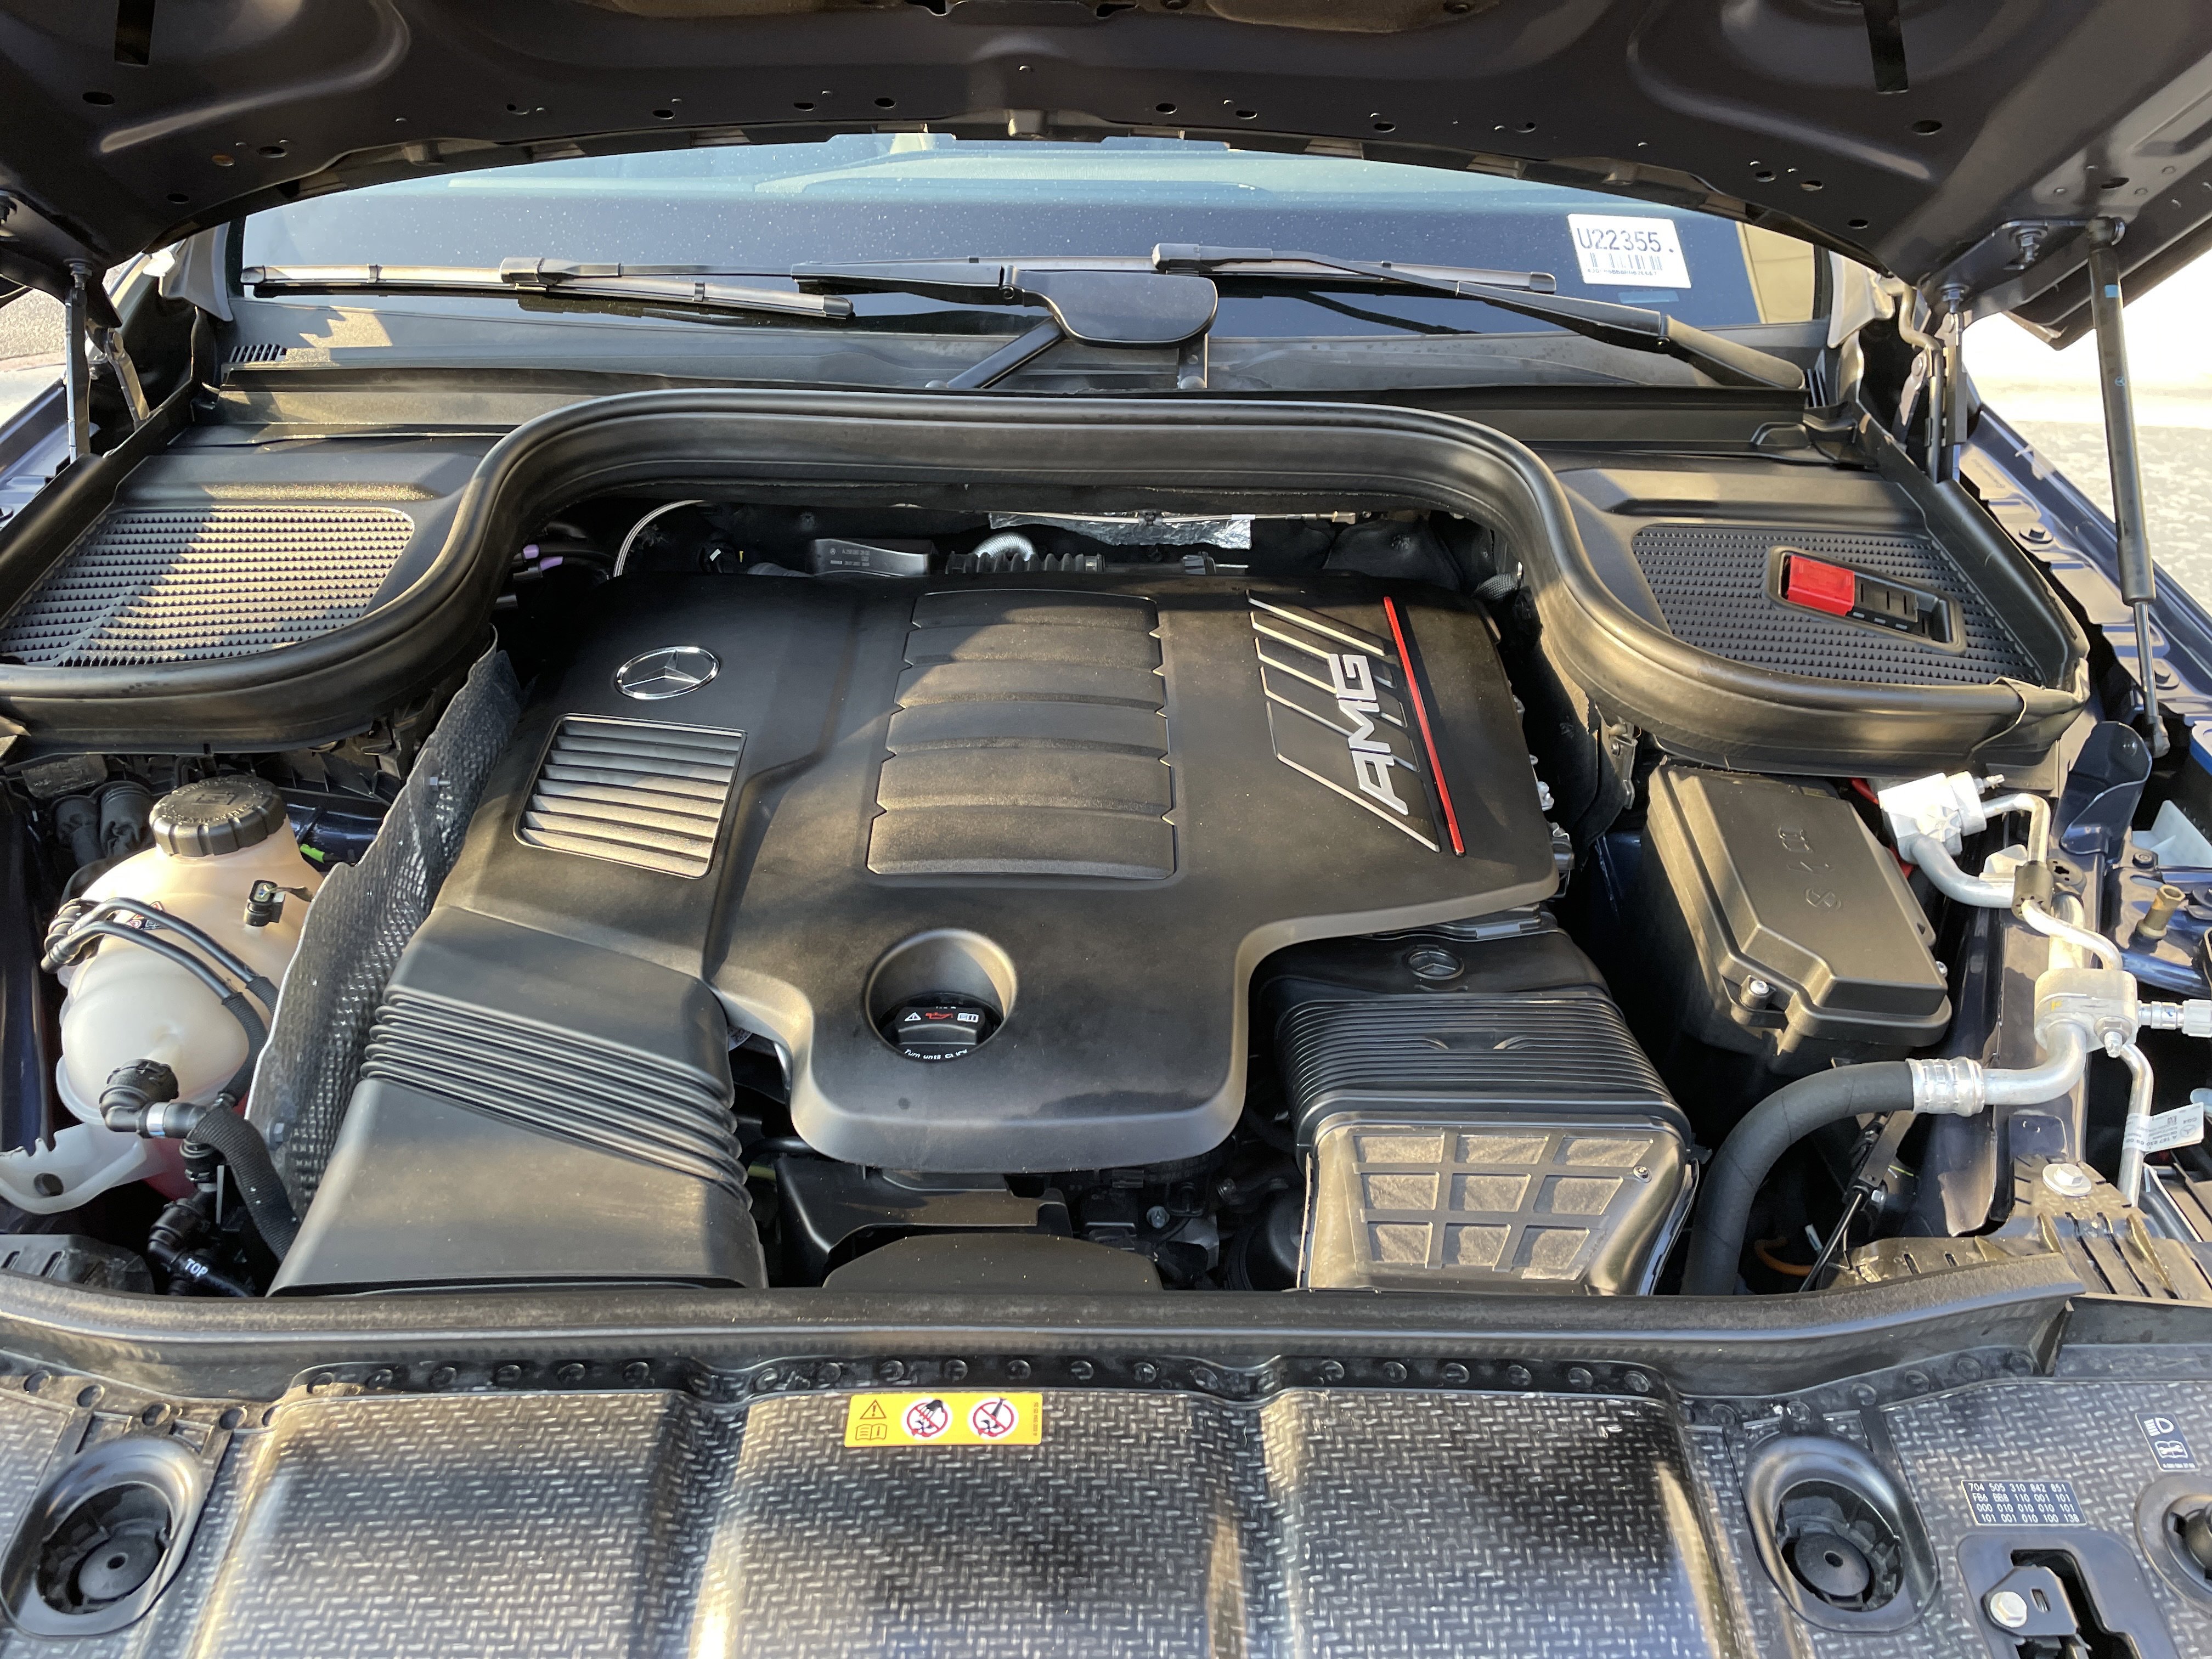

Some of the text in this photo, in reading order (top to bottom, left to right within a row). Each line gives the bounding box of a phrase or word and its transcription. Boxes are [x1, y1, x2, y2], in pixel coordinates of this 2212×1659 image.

[1328, 653, 1409, 816] AMG
[904, 1049, 921, 1058] Turn
[184, 1257, 208, 1277] TOP
[1968, 1483, 2067, 1492] 704 505 310 842 851
[2015, 1493, 2030, 1502] 110
[2034, 1493, 2050, 1502] 001
[2056, 1493, 2070, 1502] 101
[1977, 1503, 2075, 1513] 000 010 010 010 101
[1982, 1514, 1996, 1523] 101
[2001, 1514, 2017, 1523] 001
[2022, 1514, 2038, 1523] 010
[2043, 1514, 2059, 1523] 100
